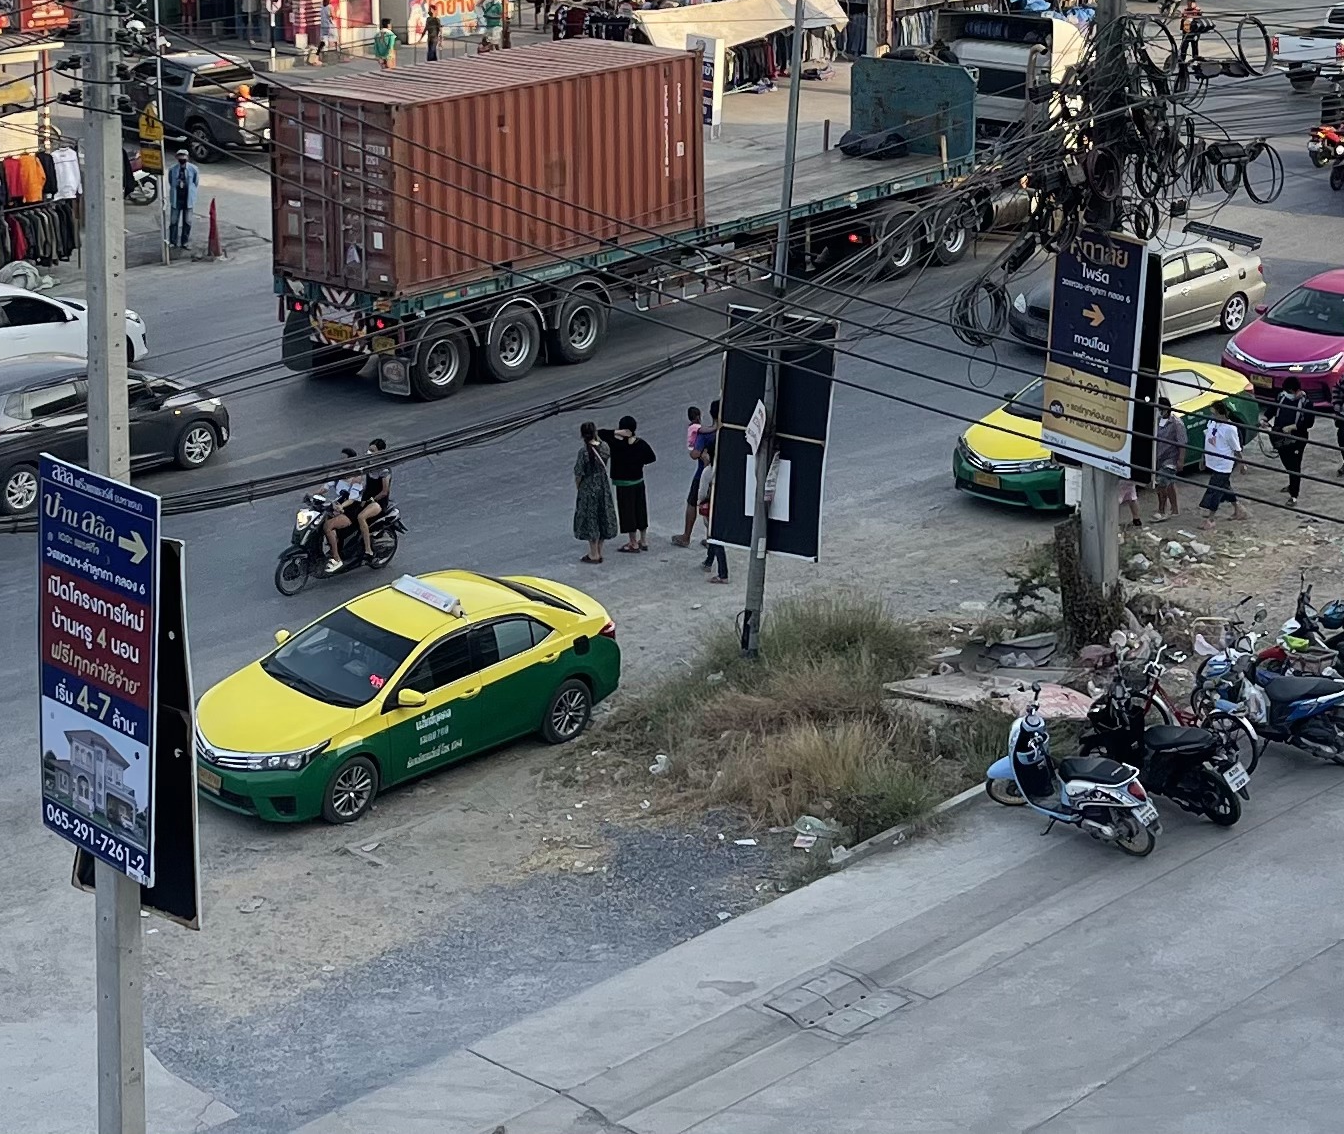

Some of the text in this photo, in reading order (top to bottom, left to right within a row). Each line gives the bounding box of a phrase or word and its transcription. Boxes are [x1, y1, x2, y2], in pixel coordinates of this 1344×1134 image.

[1125, 295, 1131, 304] 6
[51, 464, 74, 487] ลลิล
[43, 491, 116, 544] บ้าน ลลิล
[47, 574, 145, 633] เปิดโครงการใหม่
[114, 574, 138, 593] คลอง
[139, 584, 146, 596] 6
[51, 605, 141, 665] บ้านหรู 4 นอน
[55, 677, 74, 706] เริ่ม
[76, 685, 111, 722] 4-7
[46, 802, 146, 876] 065-291-7261-2
